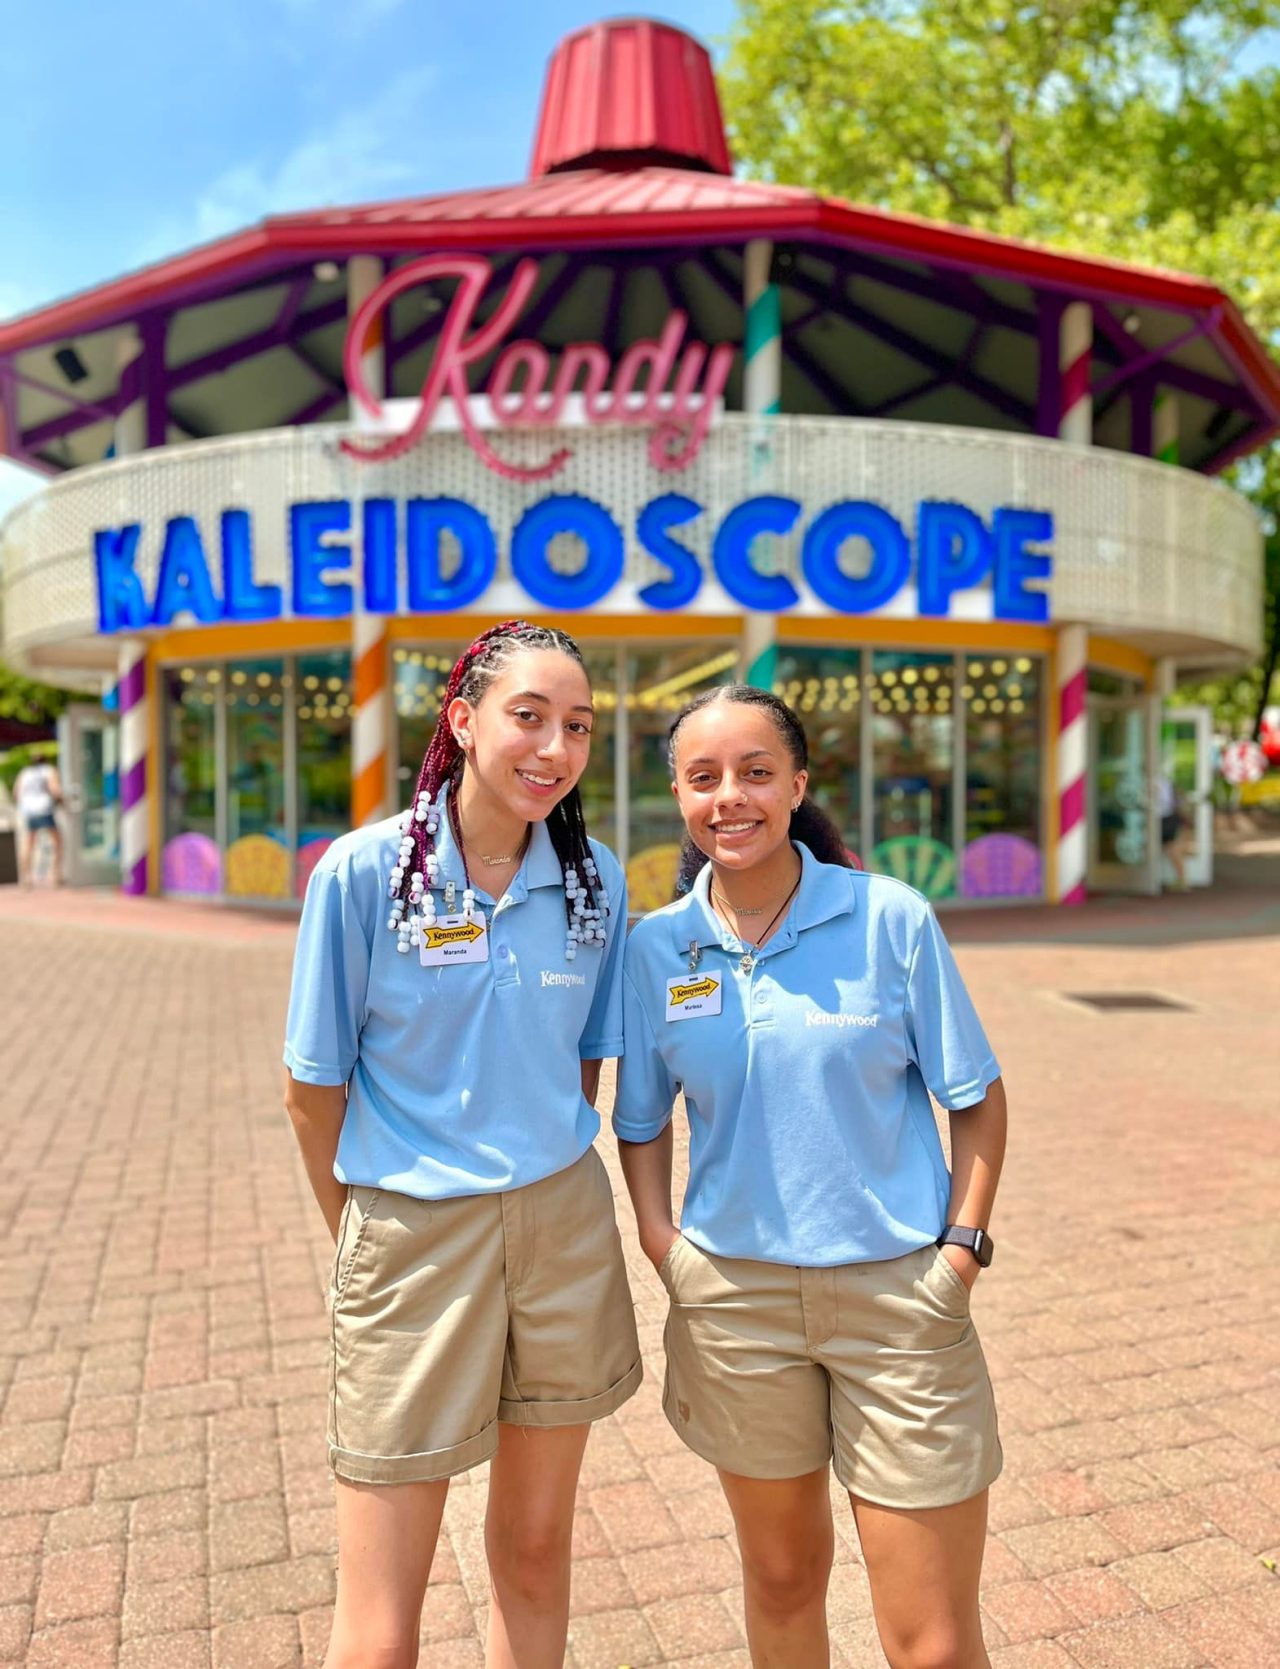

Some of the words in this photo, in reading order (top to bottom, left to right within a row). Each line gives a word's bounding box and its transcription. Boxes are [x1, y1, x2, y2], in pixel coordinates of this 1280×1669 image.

[340, 252, 733, 482] Kandy
[94, 493, 1054, 633] KALEIDOSCOPE
[433, 928, 475, 941] Kennywood
[540, 970, 586, 988] Kennywood
[677, 982, 711, 998] Kennywood
[805, 1011, 879, 1028] Kennywood
